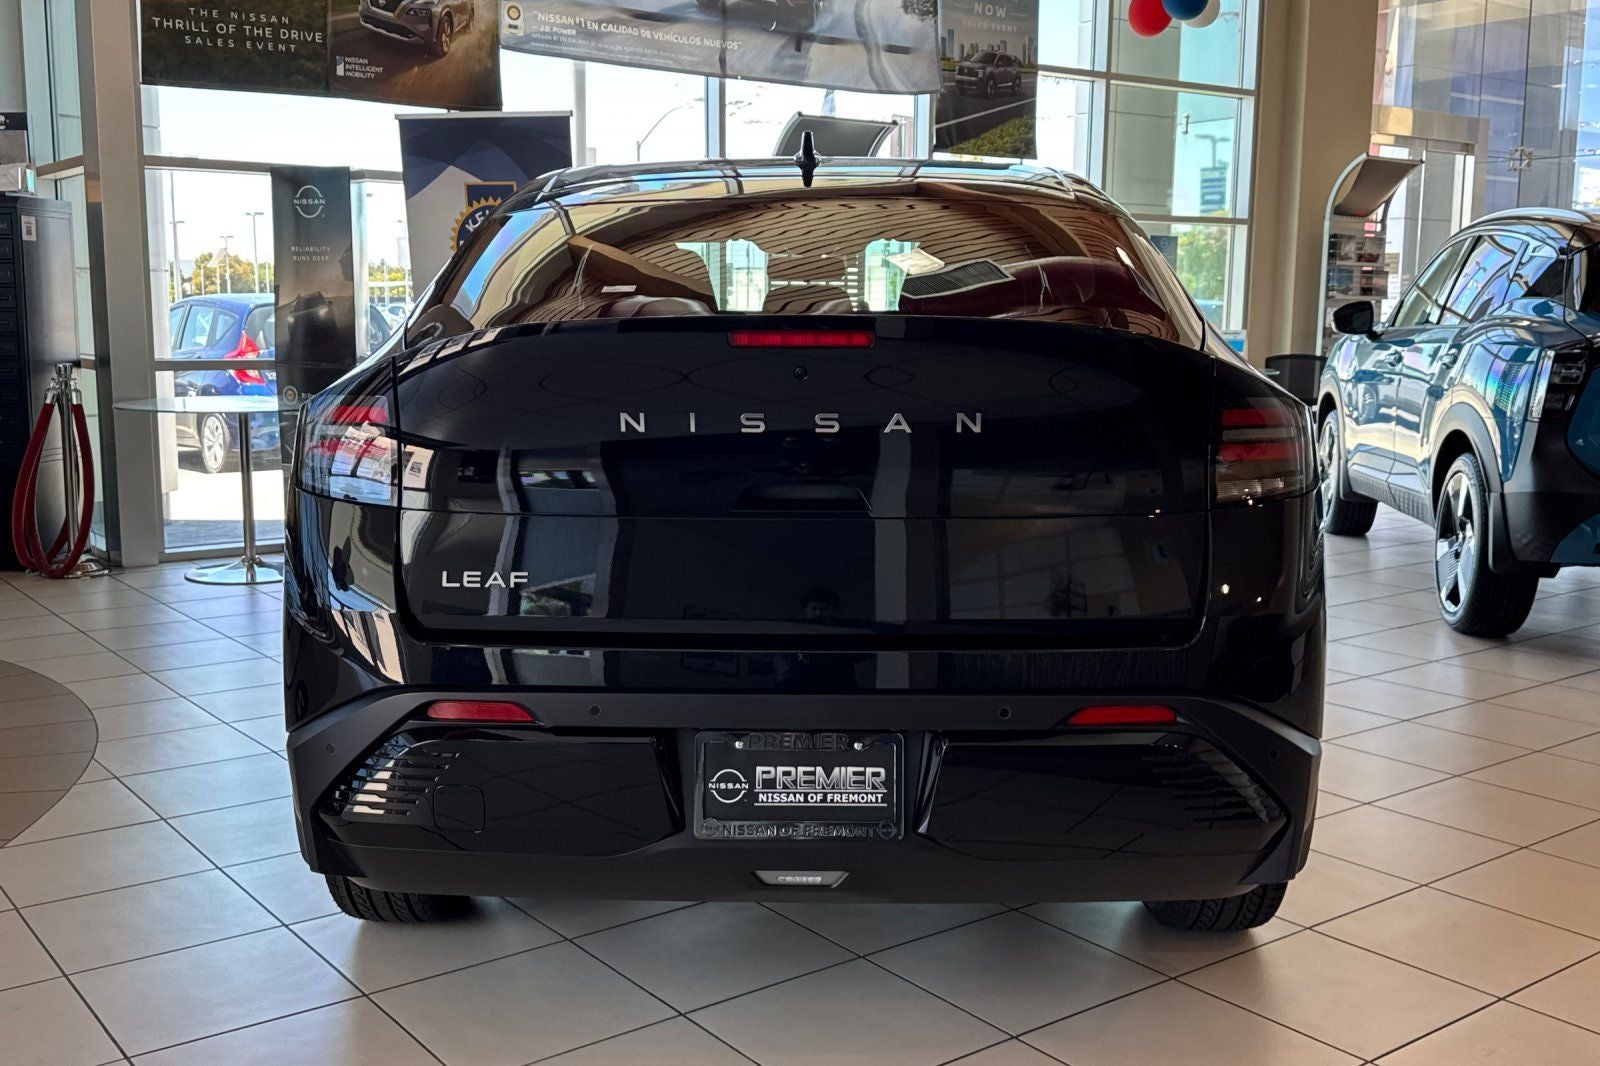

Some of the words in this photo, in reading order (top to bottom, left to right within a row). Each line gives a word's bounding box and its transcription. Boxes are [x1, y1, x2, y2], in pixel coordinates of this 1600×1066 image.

[188, 7, 219, 18] THE
[230, 11, 290, 25] NISSAN
[974, 2, 1007, 18] NOW
[152, 16, 210, 33] THRILL
[215, 23, 237, 35] OF
[243, 25, 273, 39] THE
[279, 28, 323, 43] DRIVE
[552, 27, 577, 36] POWER
[587, 20, 599, 31] EN
[600, 22, 639, 36] CALIDAD
[640, 29, 652, 39] DE
[652, 30, 702, 46] VEHÍCULOS
[184, 35, 235, 48] SALES
[246, 41, 297, 53] EVENT
[344, 56, 369, 64] NISSAN
[345, 63, 384, 73] INTELLIGENT
[345, 71, 375, 79] MOBILITY
[619, 412, 982, 434] NISSAN
[441, 570, 529, 588] LEAF
[749, 733, 850, 750] PREMIER
[755, 765, 886, 790] PREMIER
[708, 782, 749, 790] NISSAN
[758, 793, 804, 803] NISSAN
[807, 793, 824, 803] OF
[827, 793, 884, 803] FREMONT
[722, 823, 778, 837] NISSAN
[780, 823, 800, 837] OF
[803, 823, 876, 838] FREMONT
